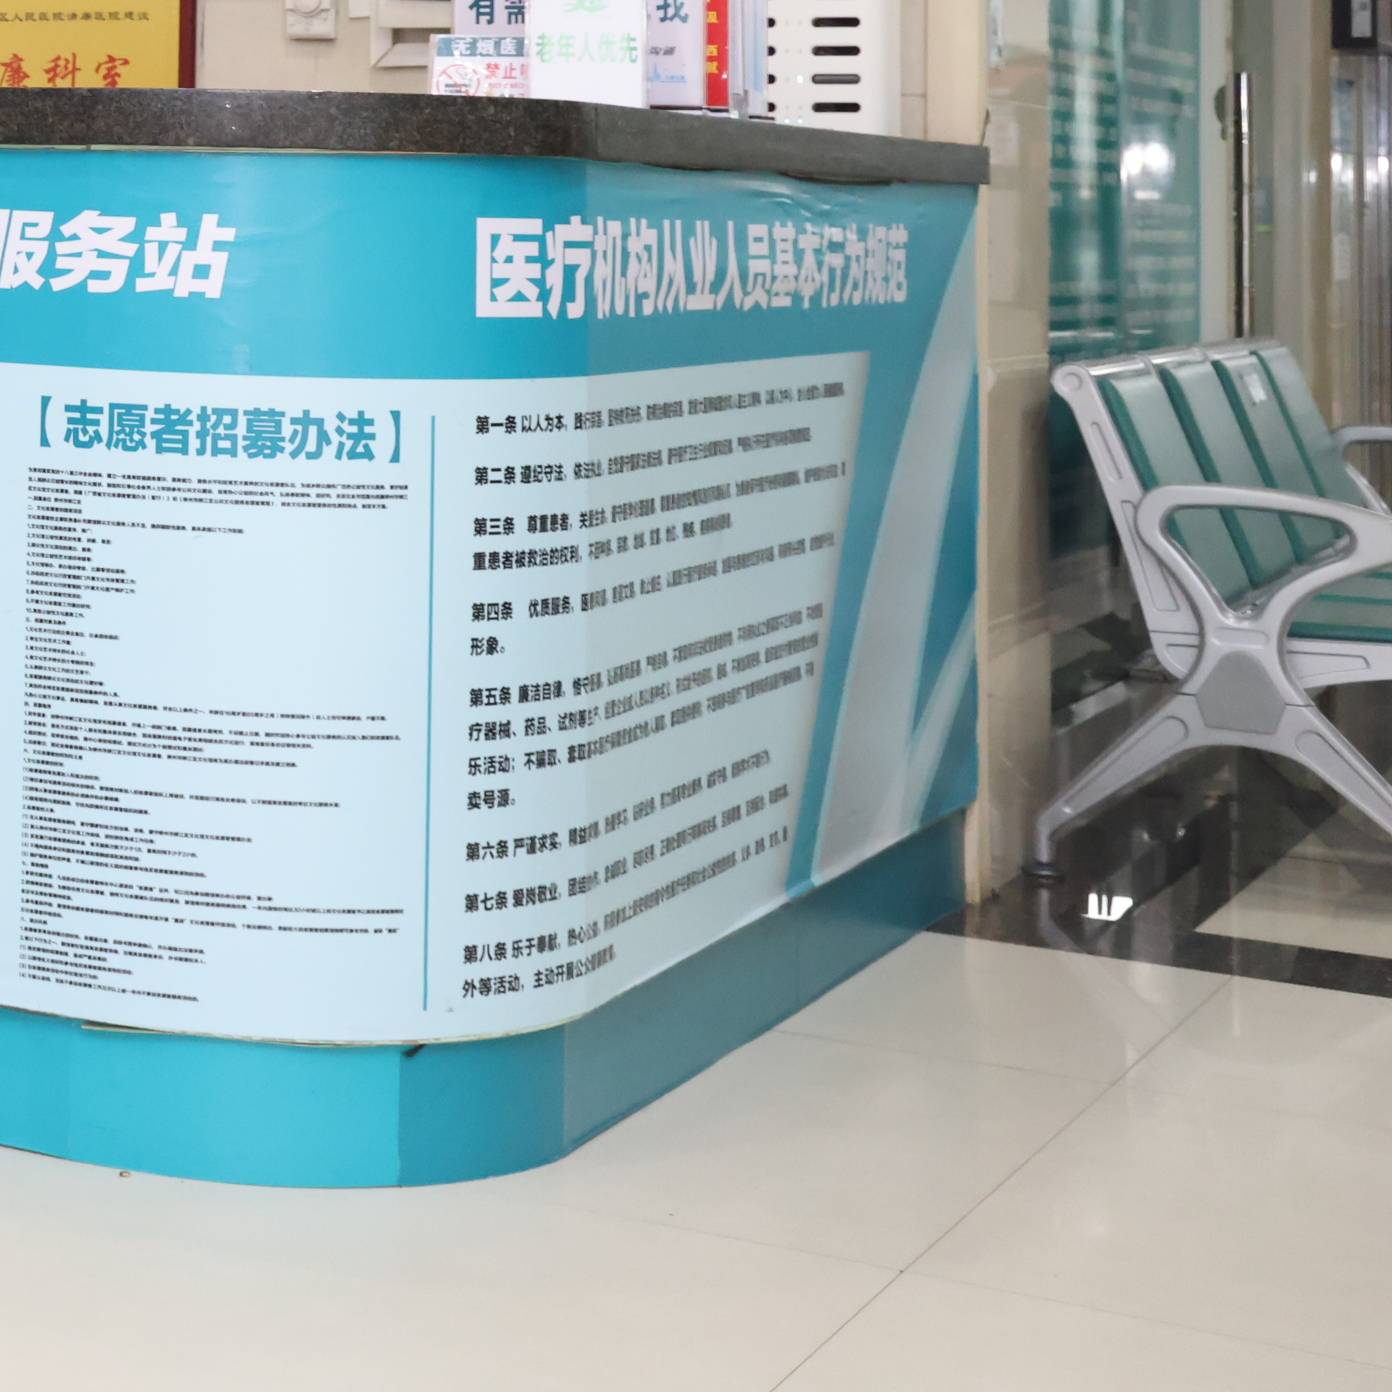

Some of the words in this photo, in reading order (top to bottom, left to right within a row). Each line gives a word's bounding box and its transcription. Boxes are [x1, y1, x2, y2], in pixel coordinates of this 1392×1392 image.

[535, 32, 640, 64] 老年人优先
[475, 214, 910, 320] 医疗机构从业人员基本行为规范
[39, 395, 402, 464] 【志愿者招募办法】
[475, 415, 517, 435] 第一条
[474, 465, 516, 486] 第二条
[473, 516, 515, 537] 第三条
[471, 601, 513, 622] 第四条
[470, 636, 506, 656] 形象。
[469, 687, 512, 708] 第五条
[466, 840, 509, 862] 第六条
[464, 891, 508, 913] 第七条
[463, 942, 507, 964] 第八条
